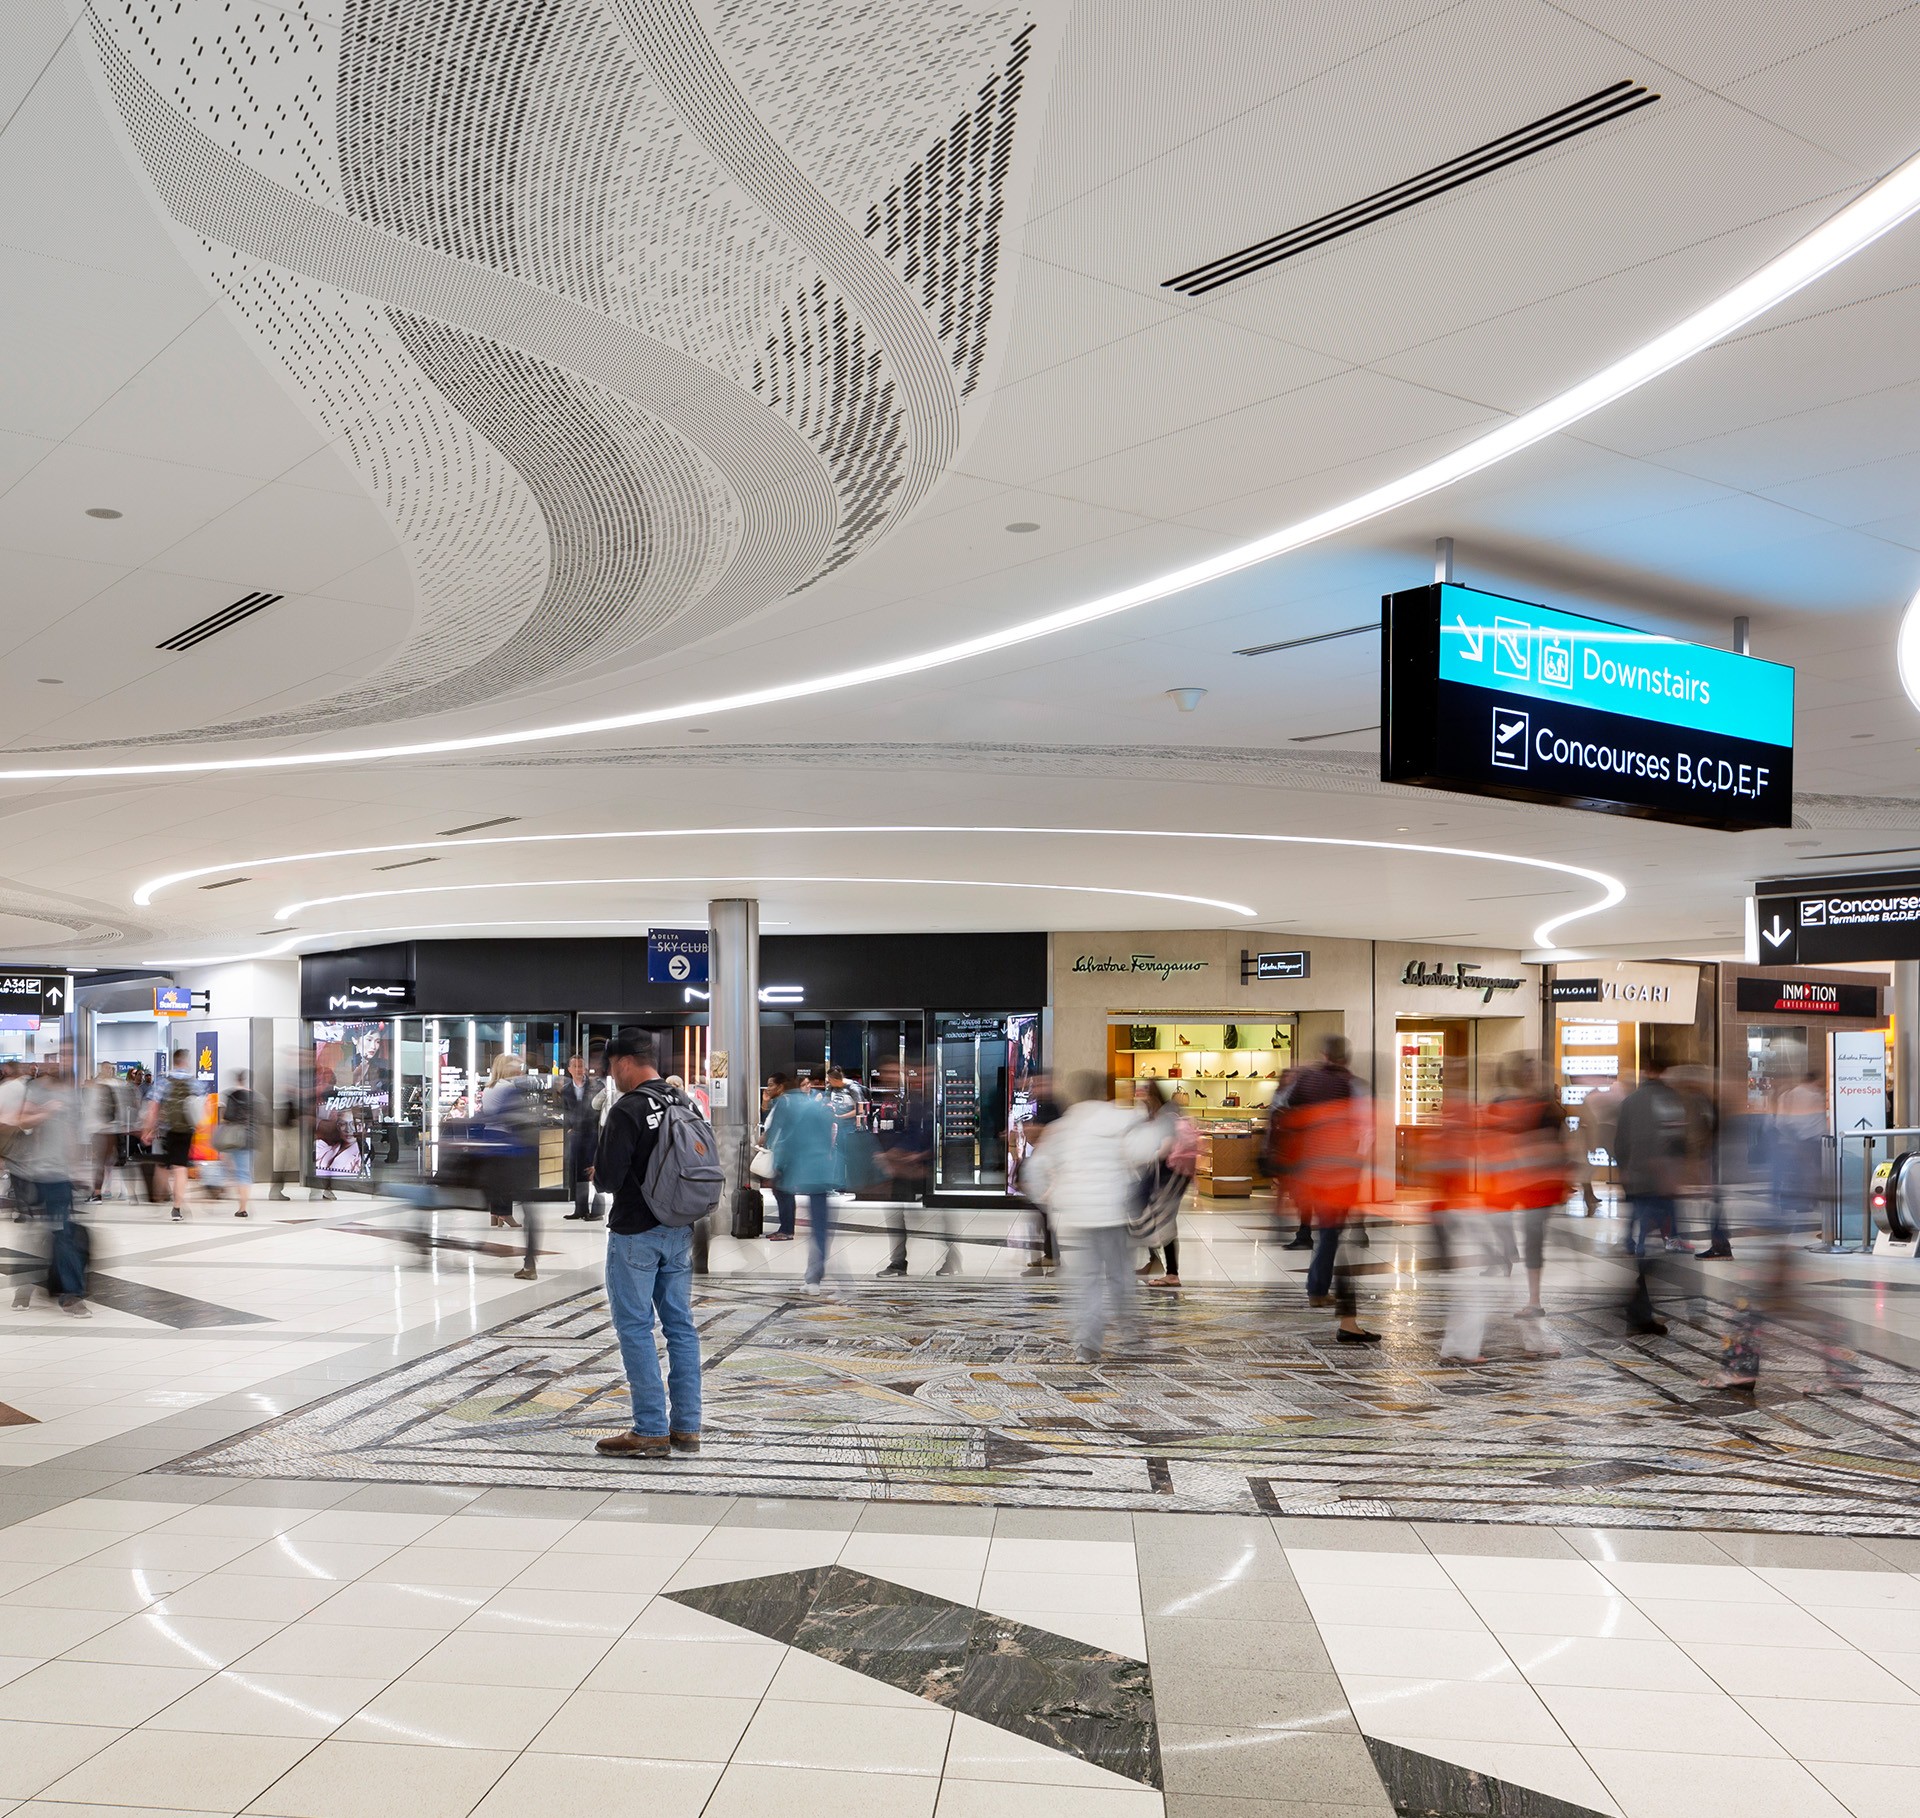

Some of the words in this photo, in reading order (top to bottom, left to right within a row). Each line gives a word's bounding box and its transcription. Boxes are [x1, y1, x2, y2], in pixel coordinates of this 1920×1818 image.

[1583, 648, 1710, 704] Downstairs
[1535, 728, 1670, 781] Concourses
[1677, 753, 1770, 799] B,C,D,E,F
[1828, 896, 1920, 914] Concourse
[1828, 912, 1880, 925] Terminales
[657, 942, 678, 952] SKY
[680, 943, 708, 953] CLUB
[1072, 956, 1129, 973] Salvatore
[1131, 955, 1209, 982] Ferragamo
[4, 979, 26, 989] A34
[1455, 963, 1527, 1003] Ferragamo
[1553, 986, 1597, 995] BVLGARI
[351, 986, 405, 996] MAC
[1602, 983, 1672, 1003] VLGARI
[1783, 984, 1836, 1001] INMOTION
[1782, 1001, 1836, 1010] ENTERTAINMENT
[1840, 1086, 1881, 1095] XpresSpa
